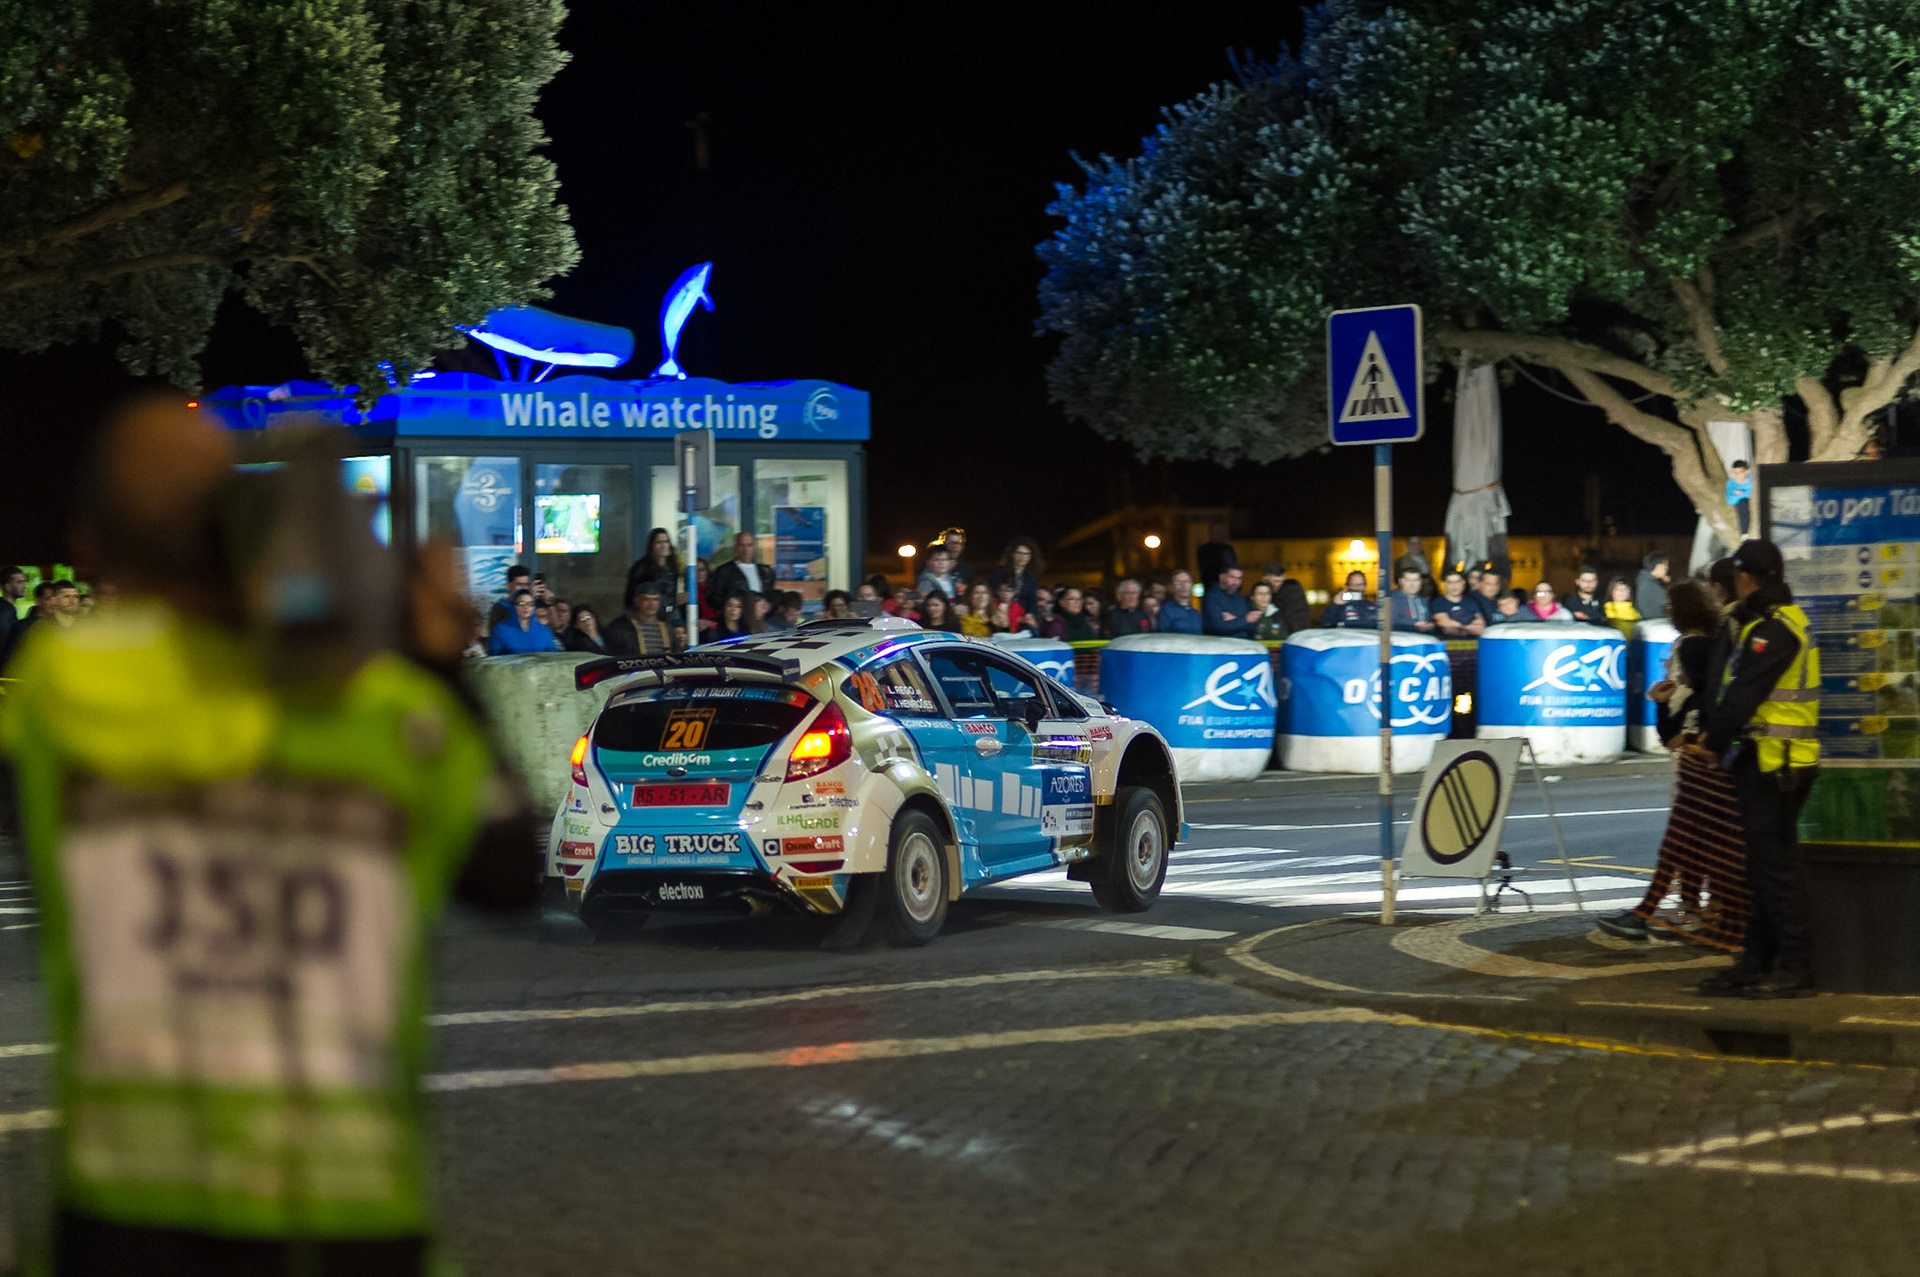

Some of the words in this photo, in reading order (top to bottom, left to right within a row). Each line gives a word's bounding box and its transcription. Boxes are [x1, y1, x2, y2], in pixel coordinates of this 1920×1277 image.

[501, 392, 611, 427] Whale
[621, 395, 778, 439] watching
[617, 657, 667, 670] azores
[683, 653, 736, 667] airlines
[692, 688, 707, 698] GOT
[665, 720, 705, 749] 20
[965, 723, 997, 734] BAHCO
[642, 753, 711, 767] Credibom
[615, 834, 656, 854] BIG
[664, 834, 741, 853] TRUCK
